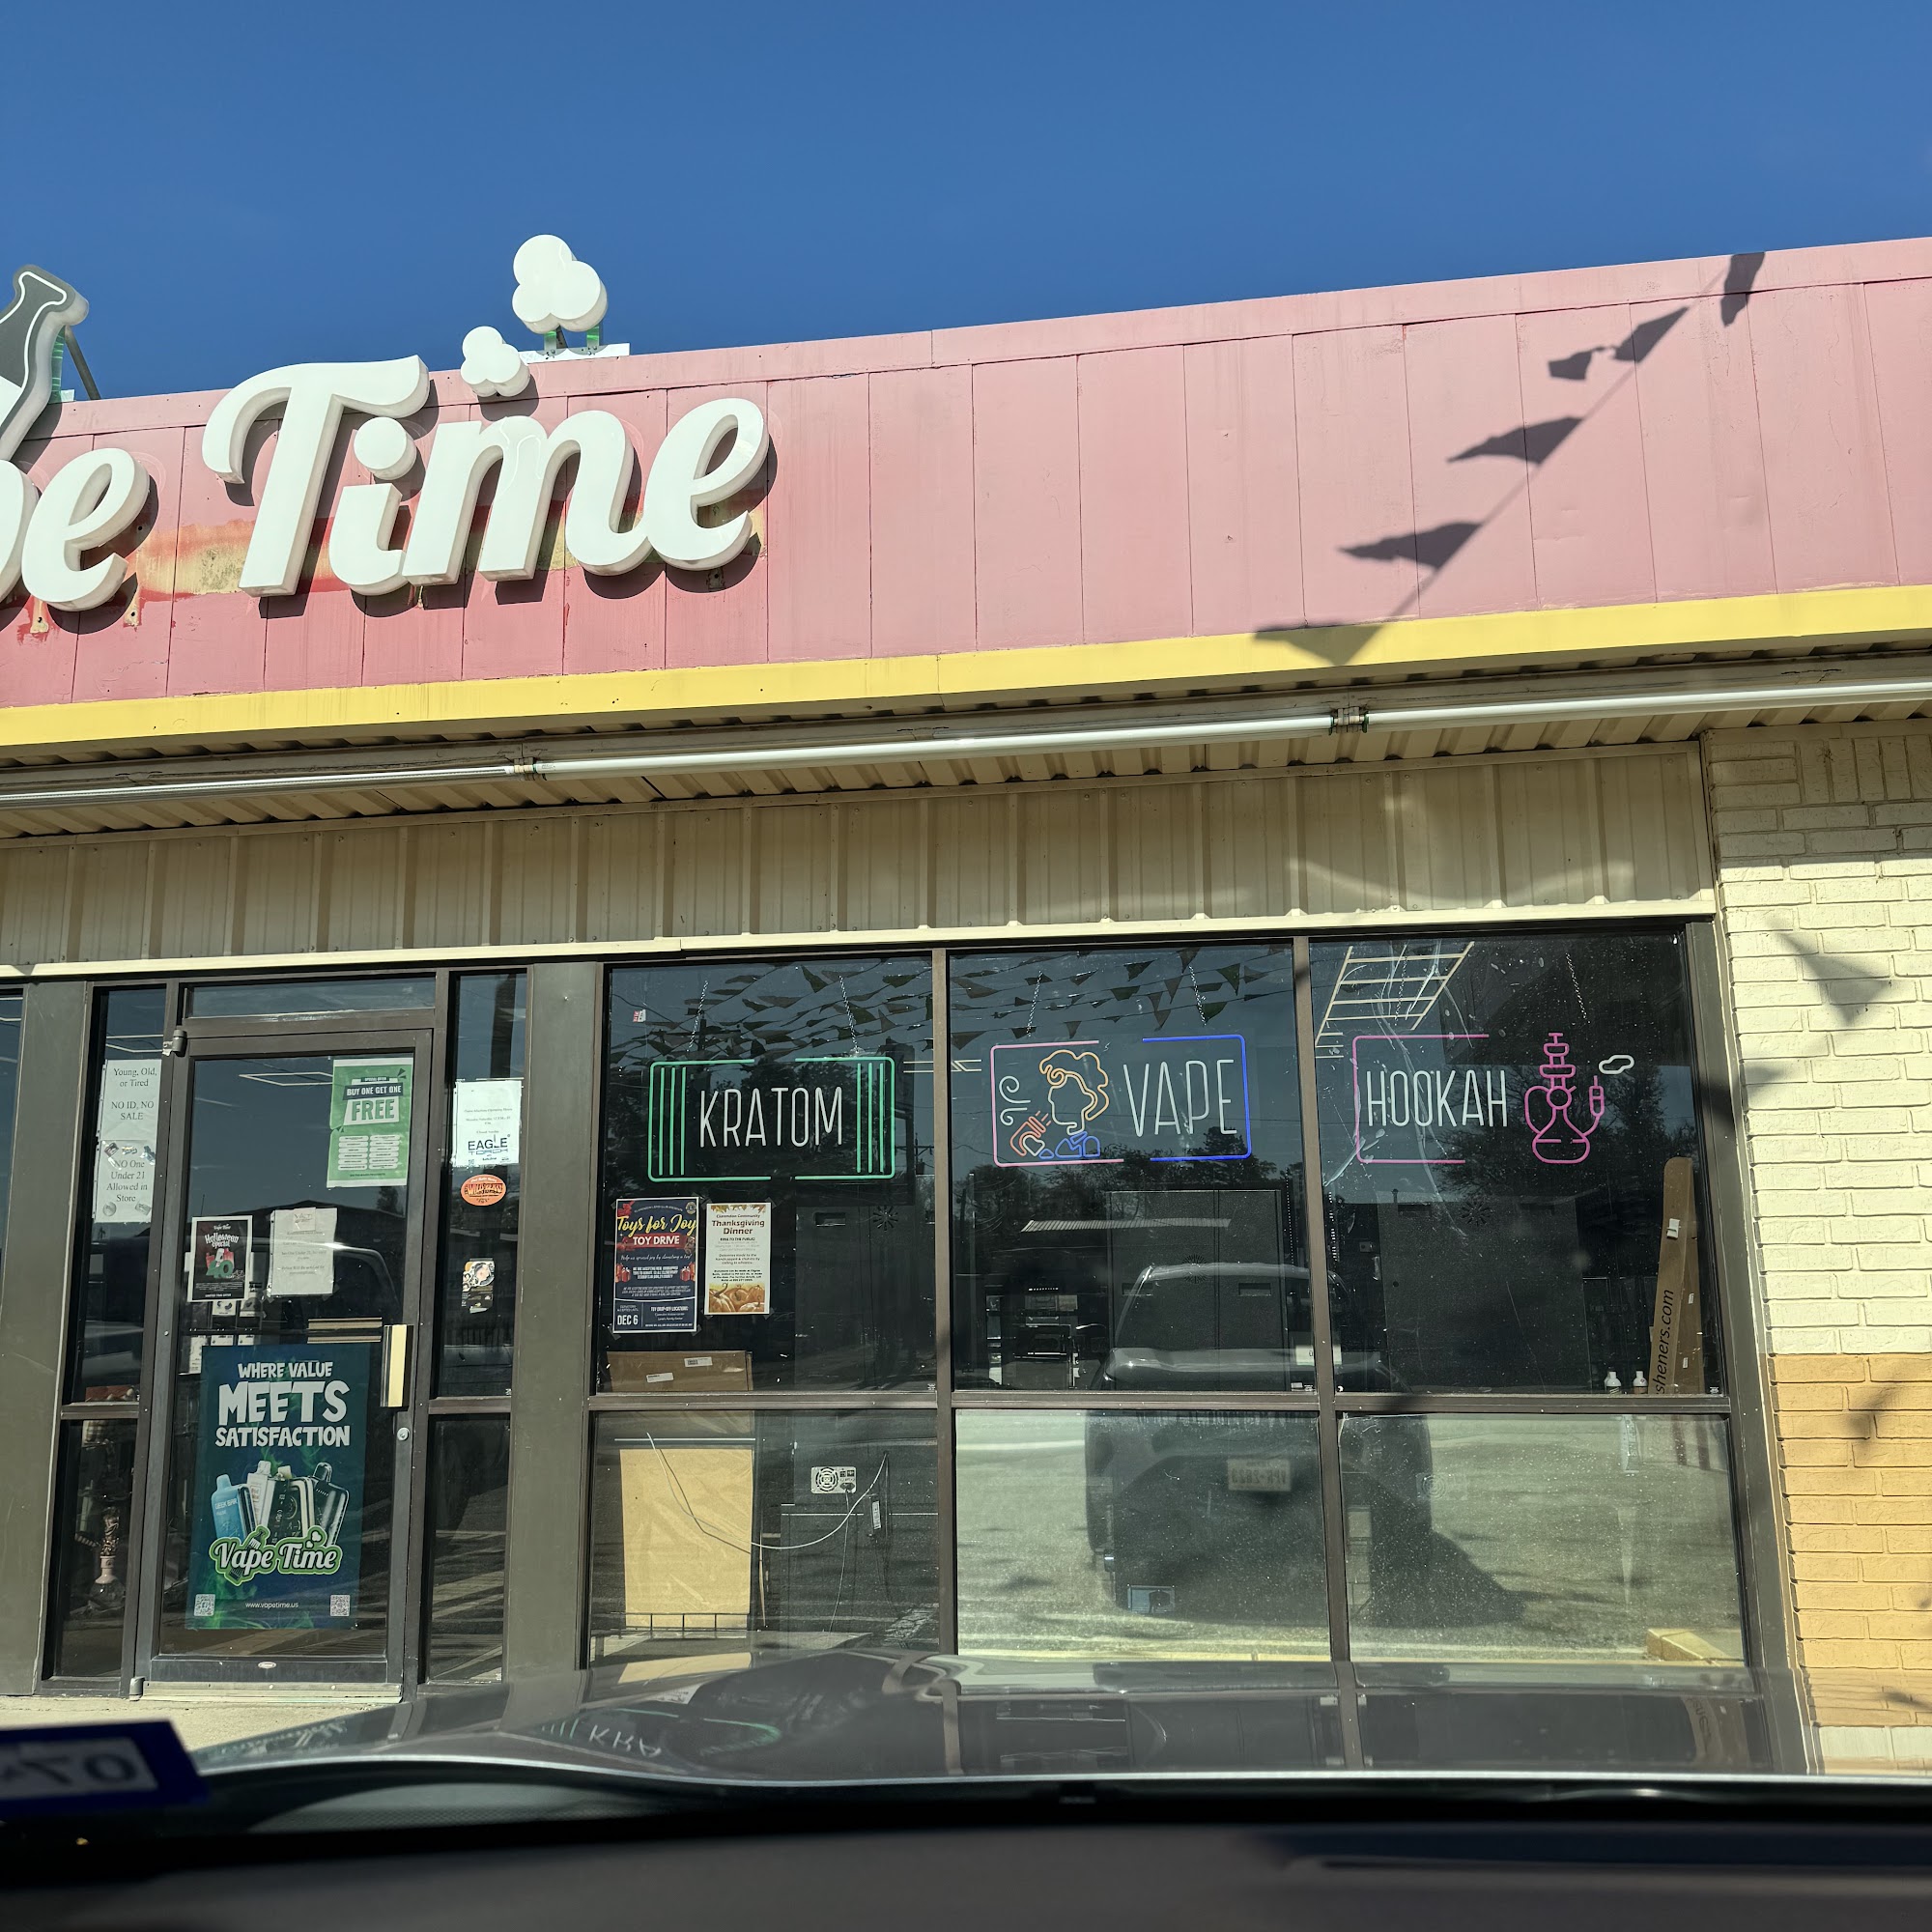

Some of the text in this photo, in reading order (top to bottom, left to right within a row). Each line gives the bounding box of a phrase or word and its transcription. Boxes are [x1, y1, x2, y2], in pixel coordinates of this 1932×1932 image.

[202, 355, 770, 595] Time
[114, 1067, 157, 1077] Young, Old,
[346, 1085, 402, 1096] BUY ONE GET ONE
[1123, 1059, 1236, 1137] VAPE
[1366, 1069, 1508, 1127] HOOKAH
[127, 1101, 139, 1110] ID,
[139, 1100, 155, 1109] NO
[352, 1098, 395, 1122] FREE
[120, 1112, 144, 1121] SALE
[700, 1086, 842, 1148] KRATOM
[468, 1134, 508, 1151] EAGLE
[129, 1159, 145, 1168] One
[110, 1171, 145, 1179] Under 21
[106, 1182, 139, 1191] Allowed
[617, 1213, 696, 1237] Toys for Joy
[204, 1232, 240, 1244] Halloween
[633, 1236, 680, 1245] TOY DRIVE
[617, 1314, 639, 1325] DEC 6
[1653, 1290, 1674, 1394] sheners.com
[238, 1361, 333, 1378] WHERE VALUE
[218, 1379, 351, 1426] MEETS
[215, 1425, 351, 1448] SATISFACTION
[214, 1543, 337, 1576] Vape Time
